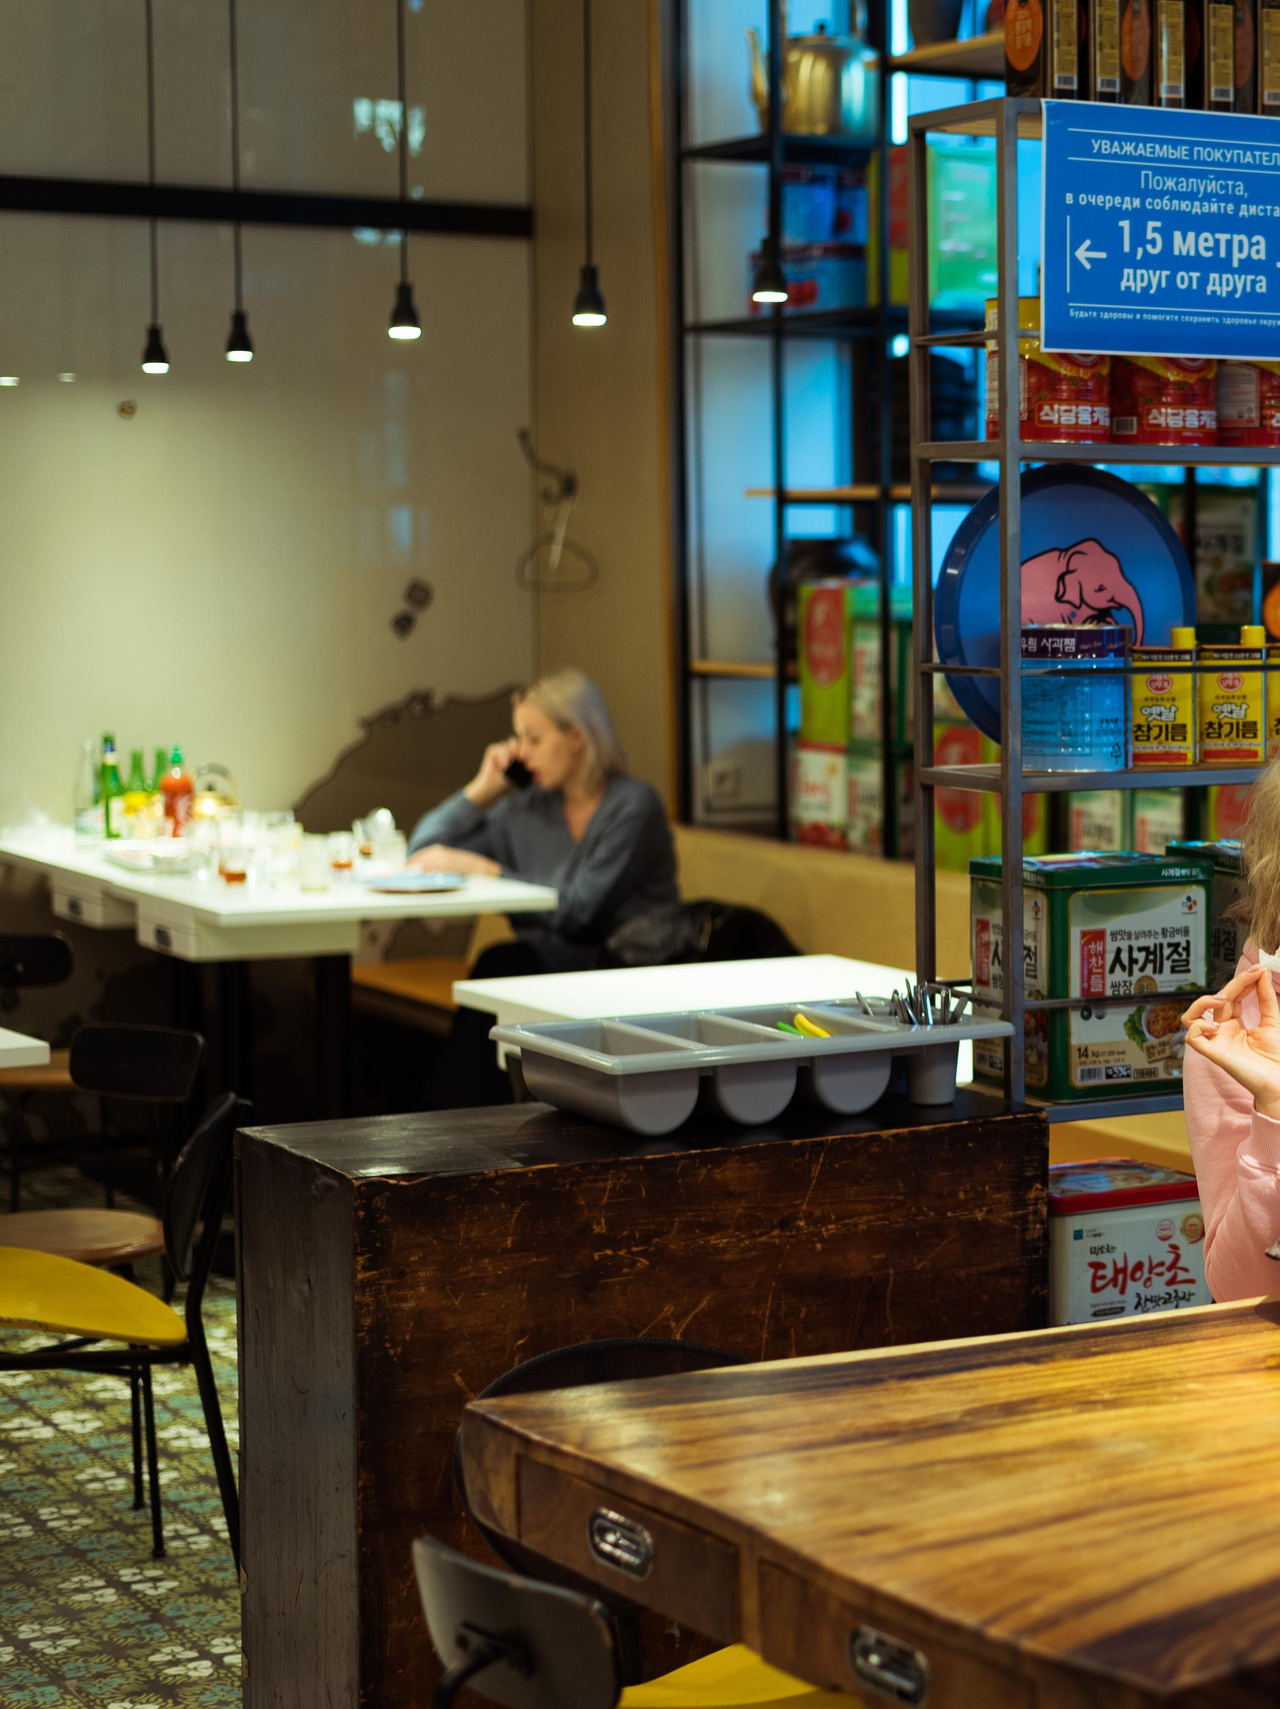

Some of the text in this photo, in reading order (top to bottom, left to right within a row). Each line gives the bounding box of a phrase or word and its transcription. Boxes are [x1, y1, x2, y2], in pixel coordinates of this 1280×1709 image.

[1091, 139, 1190, 160] УВАЖАЕМЫЕ
[1140, 171, 1249, 198] Пожалуйста,
[1066, 193, 1074, 204] в
[1079, 193, 1141, 209] очереди
[1145, 198, 1234, 215] соблюдайте
[1118, 219, 1267, 268] 1,5 метра
[1121, 267, 1267, 298] друг от друга
[1069, 309, 1097, 319] Будьте
[1099, 312, 1134, 321] здоровы
[1142, 313, 1179, 322] помогите
[1181, 315, 1220, 325] сохранить
[1222, 317, 1257, 326] здоровье
[1040, 637, 1076, 652] 사과쨈
[1141, 704, 1178, 722] 옛날
[1212, 701, 1249, 720] 옛날
[1133, 723, 1188, 742] 참기름
[1204, 721, 1258, 739] 참기름
[1109, 929, 1133, 942] 쌈맛을
[1160, 925, 1190, 939] 황금비율
[1088, 941, 1104, 993] 해찬들
[1108, 939, 1191, 977] 사계절
[1109, 980, 1133, 996] 쌈장
[1077, 1046, 1089, 1059] 14
[1091, 1049, 1100, 1059] kg
[1087, 1243, 1197, 1296] 태양초
